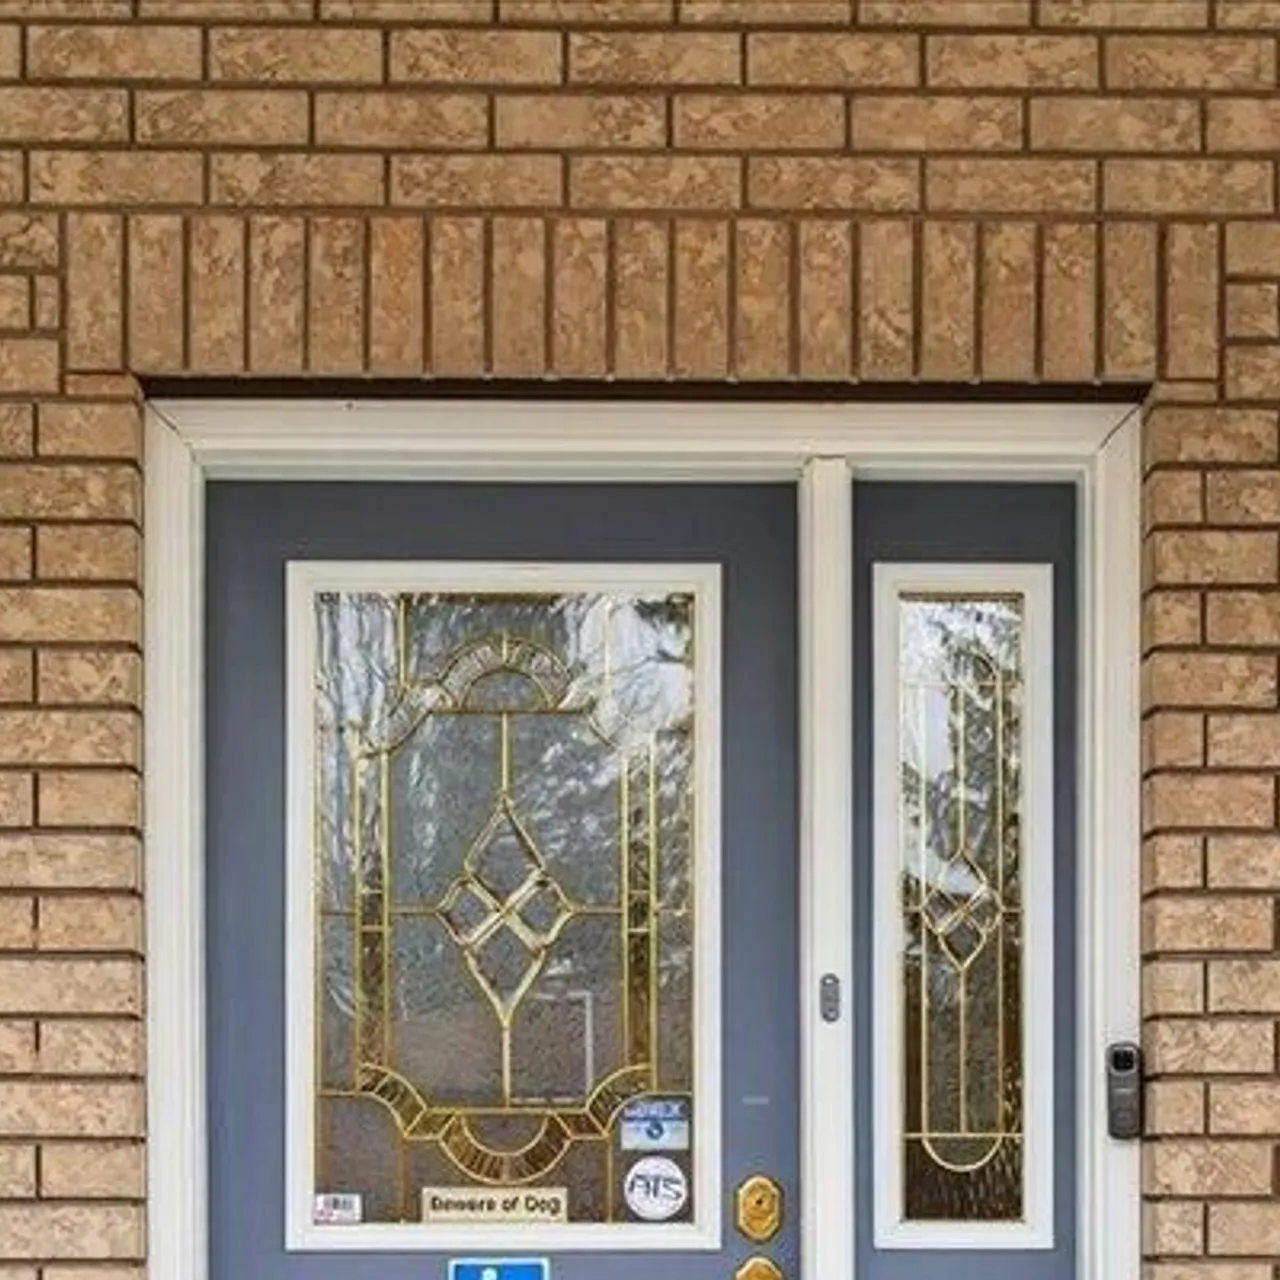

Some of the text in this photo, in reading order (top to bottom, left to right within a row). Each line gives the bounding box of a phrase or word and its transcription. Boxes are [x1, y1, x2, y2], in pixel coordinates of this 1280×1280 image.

[430, 1196, 562, 1216] Beware of Dog
